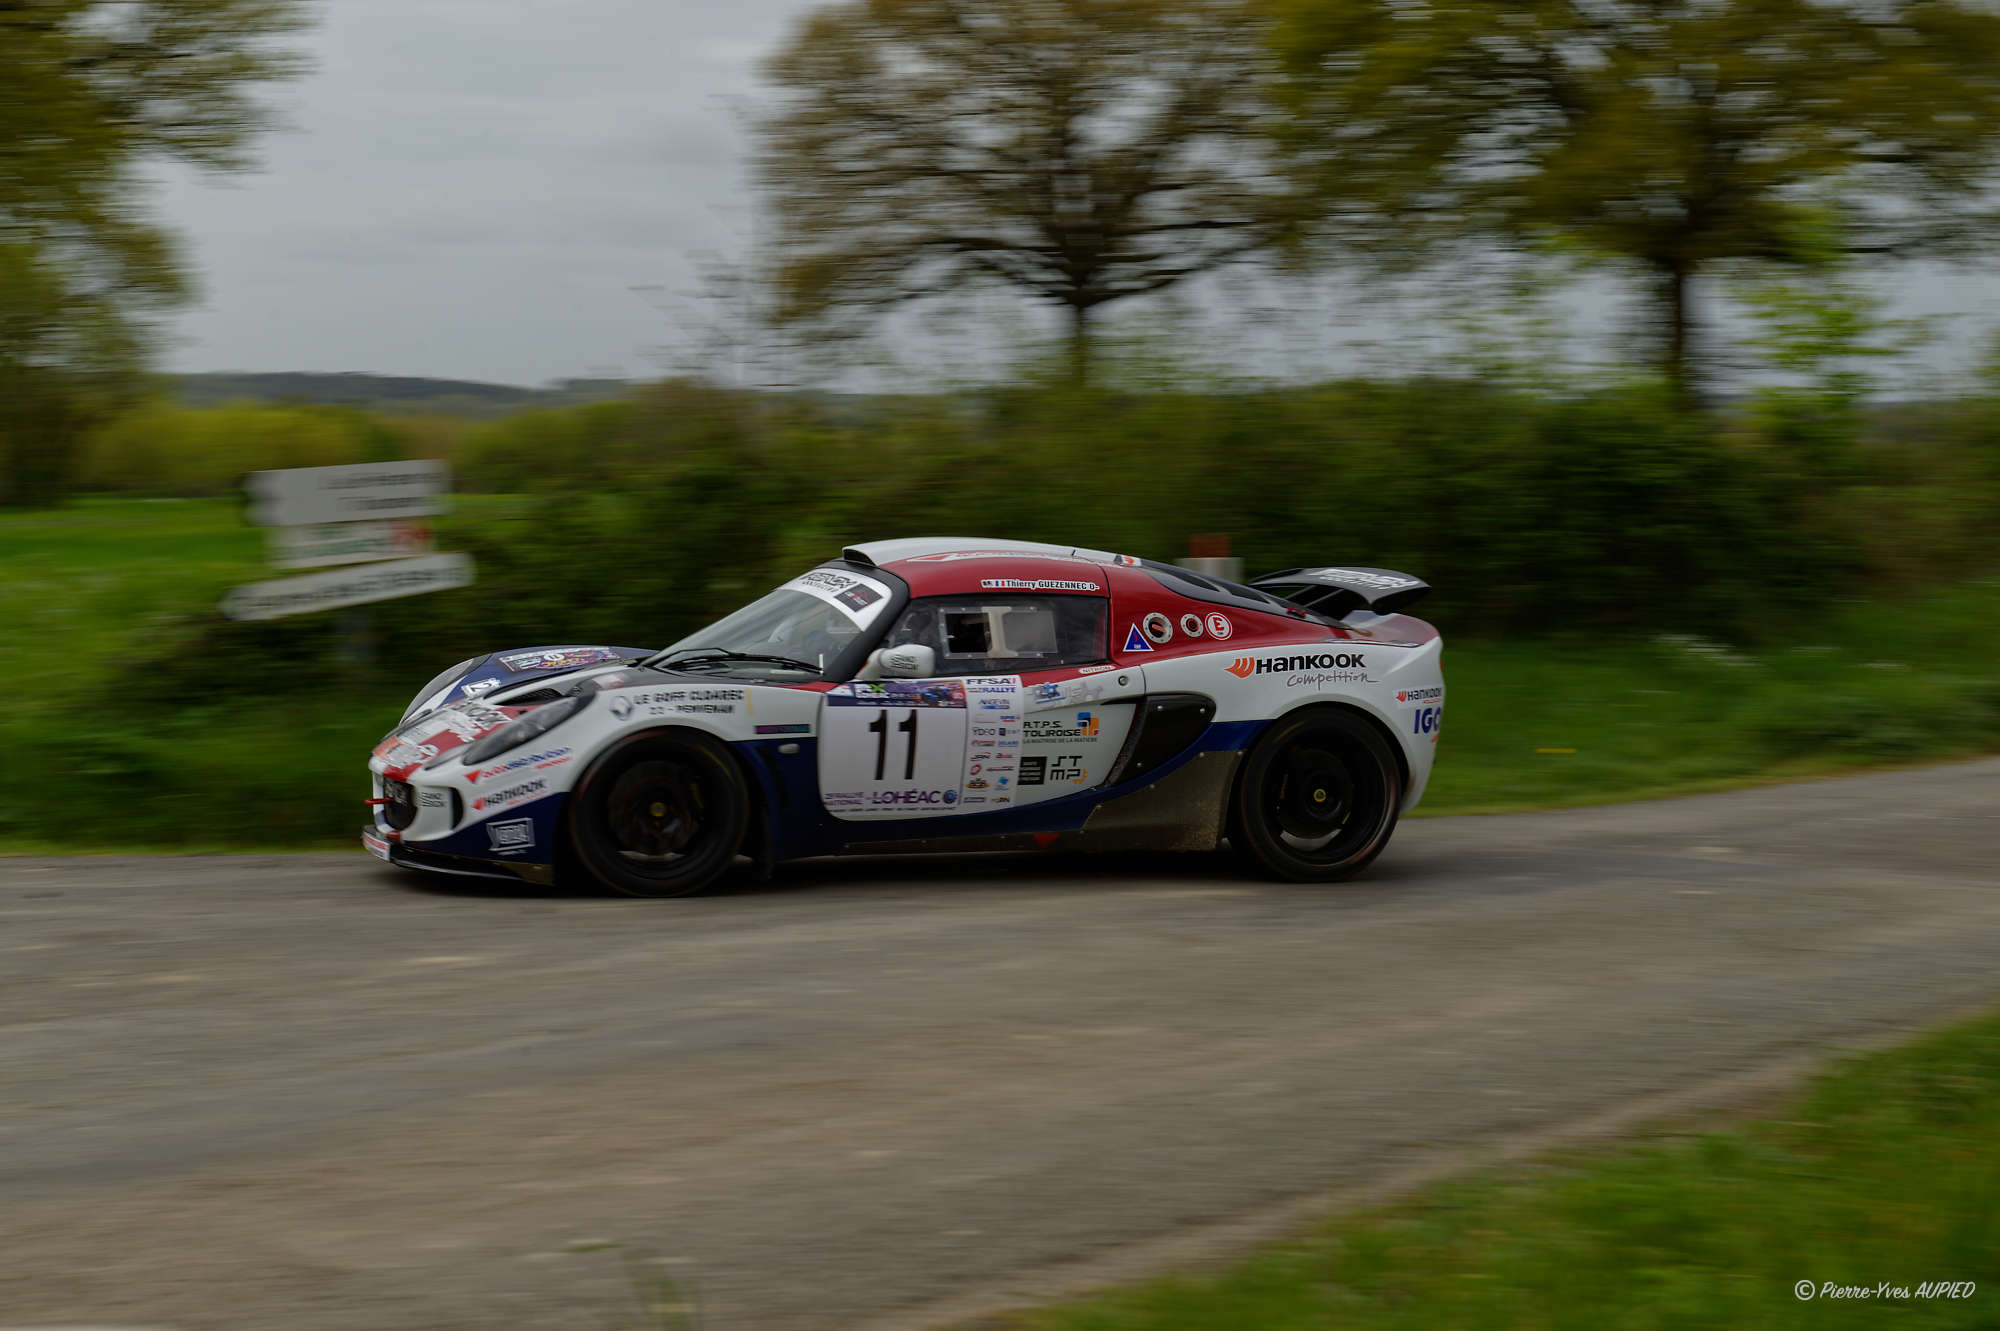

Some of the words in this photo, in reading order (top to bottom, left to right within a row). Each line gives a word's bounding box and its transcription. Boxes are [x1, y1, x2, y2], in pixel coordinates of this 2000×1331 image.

[1007, 580, 1035, 589] Thierry
[1038, 581, 1087, 590] GUEZENNEC
[1212, 617, 1225, 631] E
[1023, 728, 1080, 738] TOUROISE
[869, 709, 918, 780] 11
[872, 789, 941, 804] LOHÉAC
